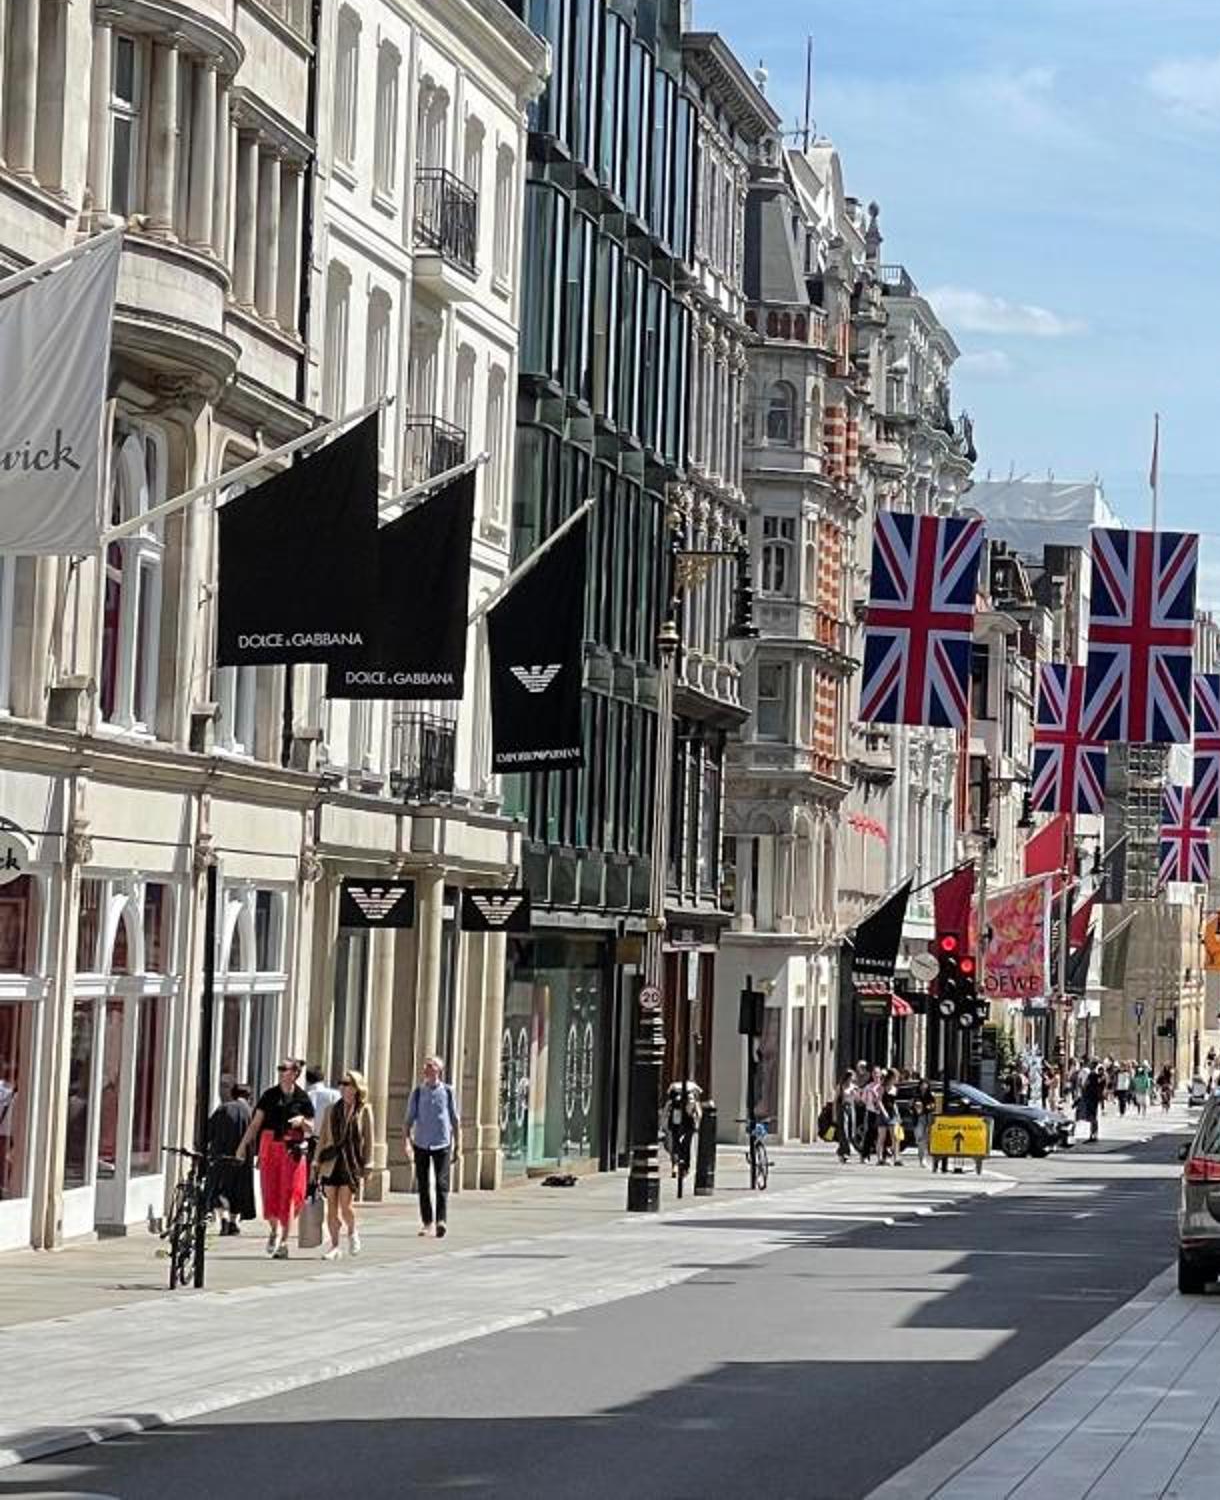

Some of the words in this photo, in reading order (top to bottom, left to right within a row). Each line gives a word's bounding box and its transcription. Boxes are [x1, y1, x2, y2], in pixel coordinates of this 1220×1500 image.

[238, 634, 284, 649] DOLCE
[292, 632, 363, 647] GABBANA
[393, 672, 454, 685] GABBANA
[984, 974, 1040, 992] OEWE
[642, 991, 658, 1003] 20
